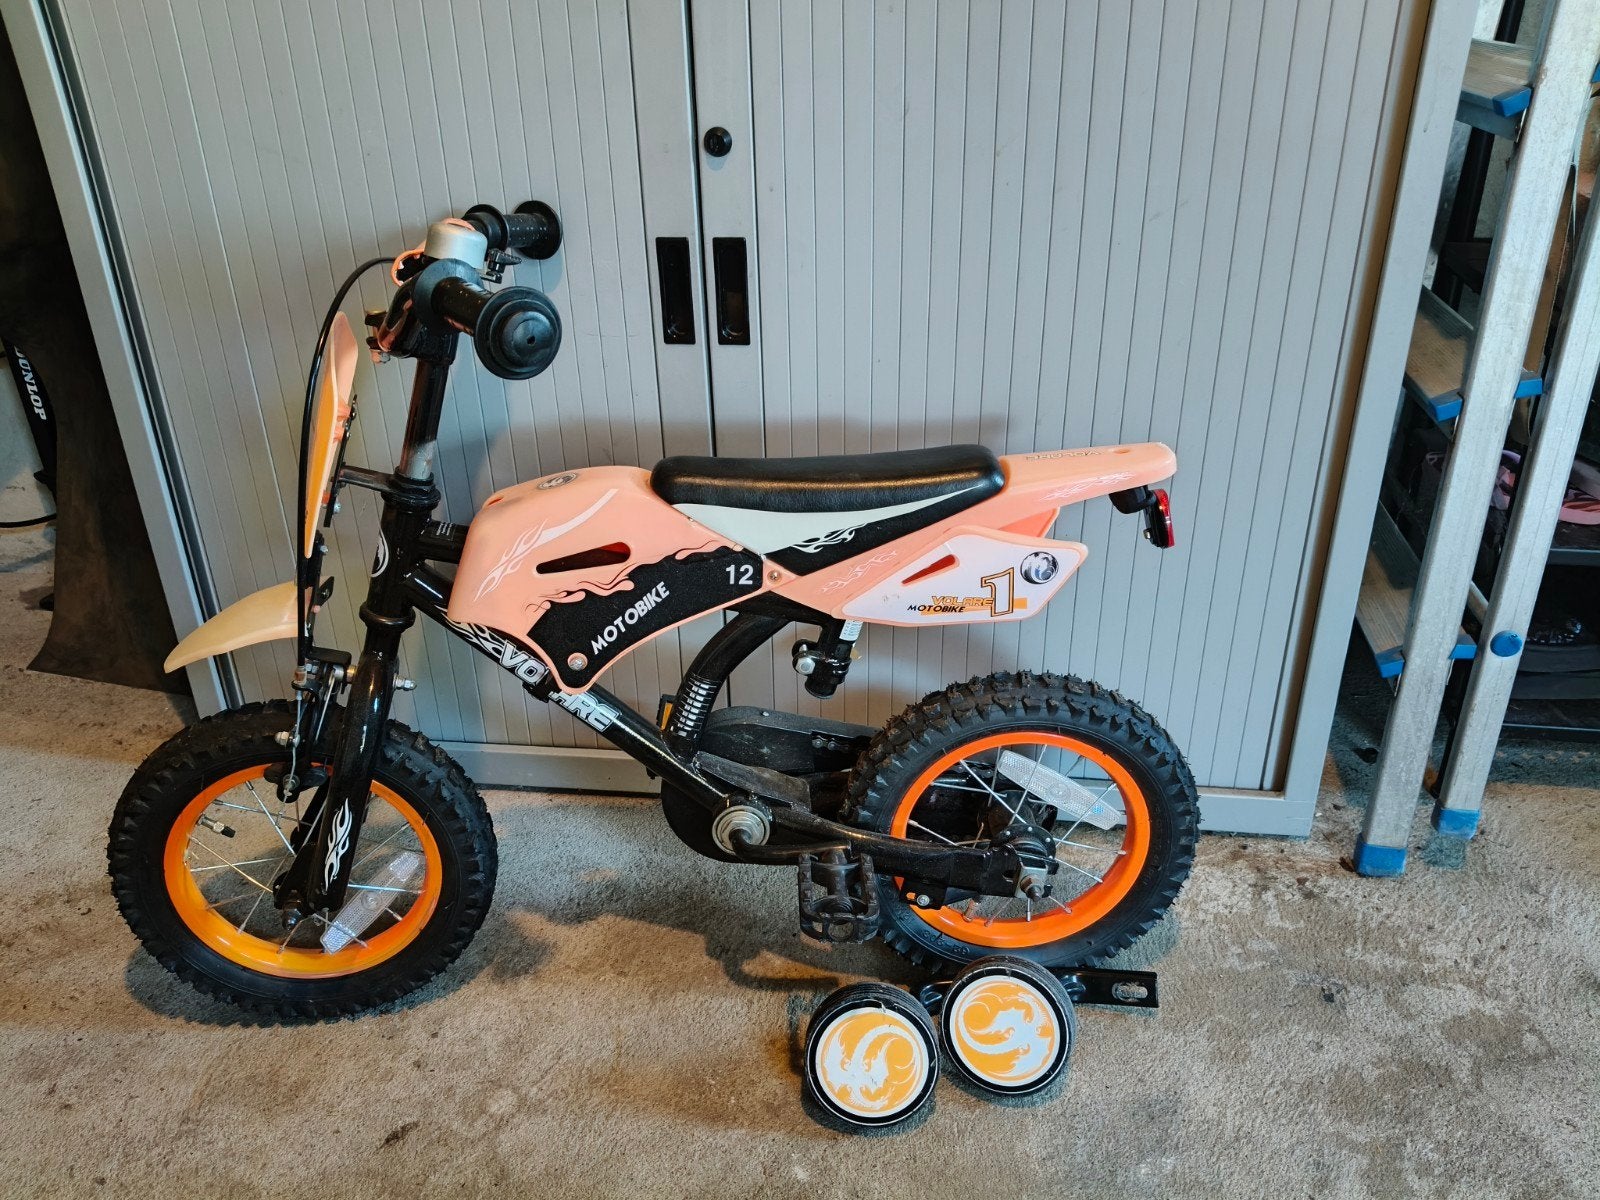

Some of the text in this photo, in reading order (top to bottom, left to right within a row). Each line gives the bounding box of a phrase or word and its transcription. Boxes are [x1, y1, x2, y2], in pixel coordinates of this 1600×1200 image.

[725, 564, 754, 585] 12
[980, 566, 1015, 618] 1
[590, 581, 670, 655] MOTOBIKE
[907, 604, 966, 613] MOTOBIKE
[931, 595, 994, 607] VOLARE
[500, 639, 622, 733] VOARE
